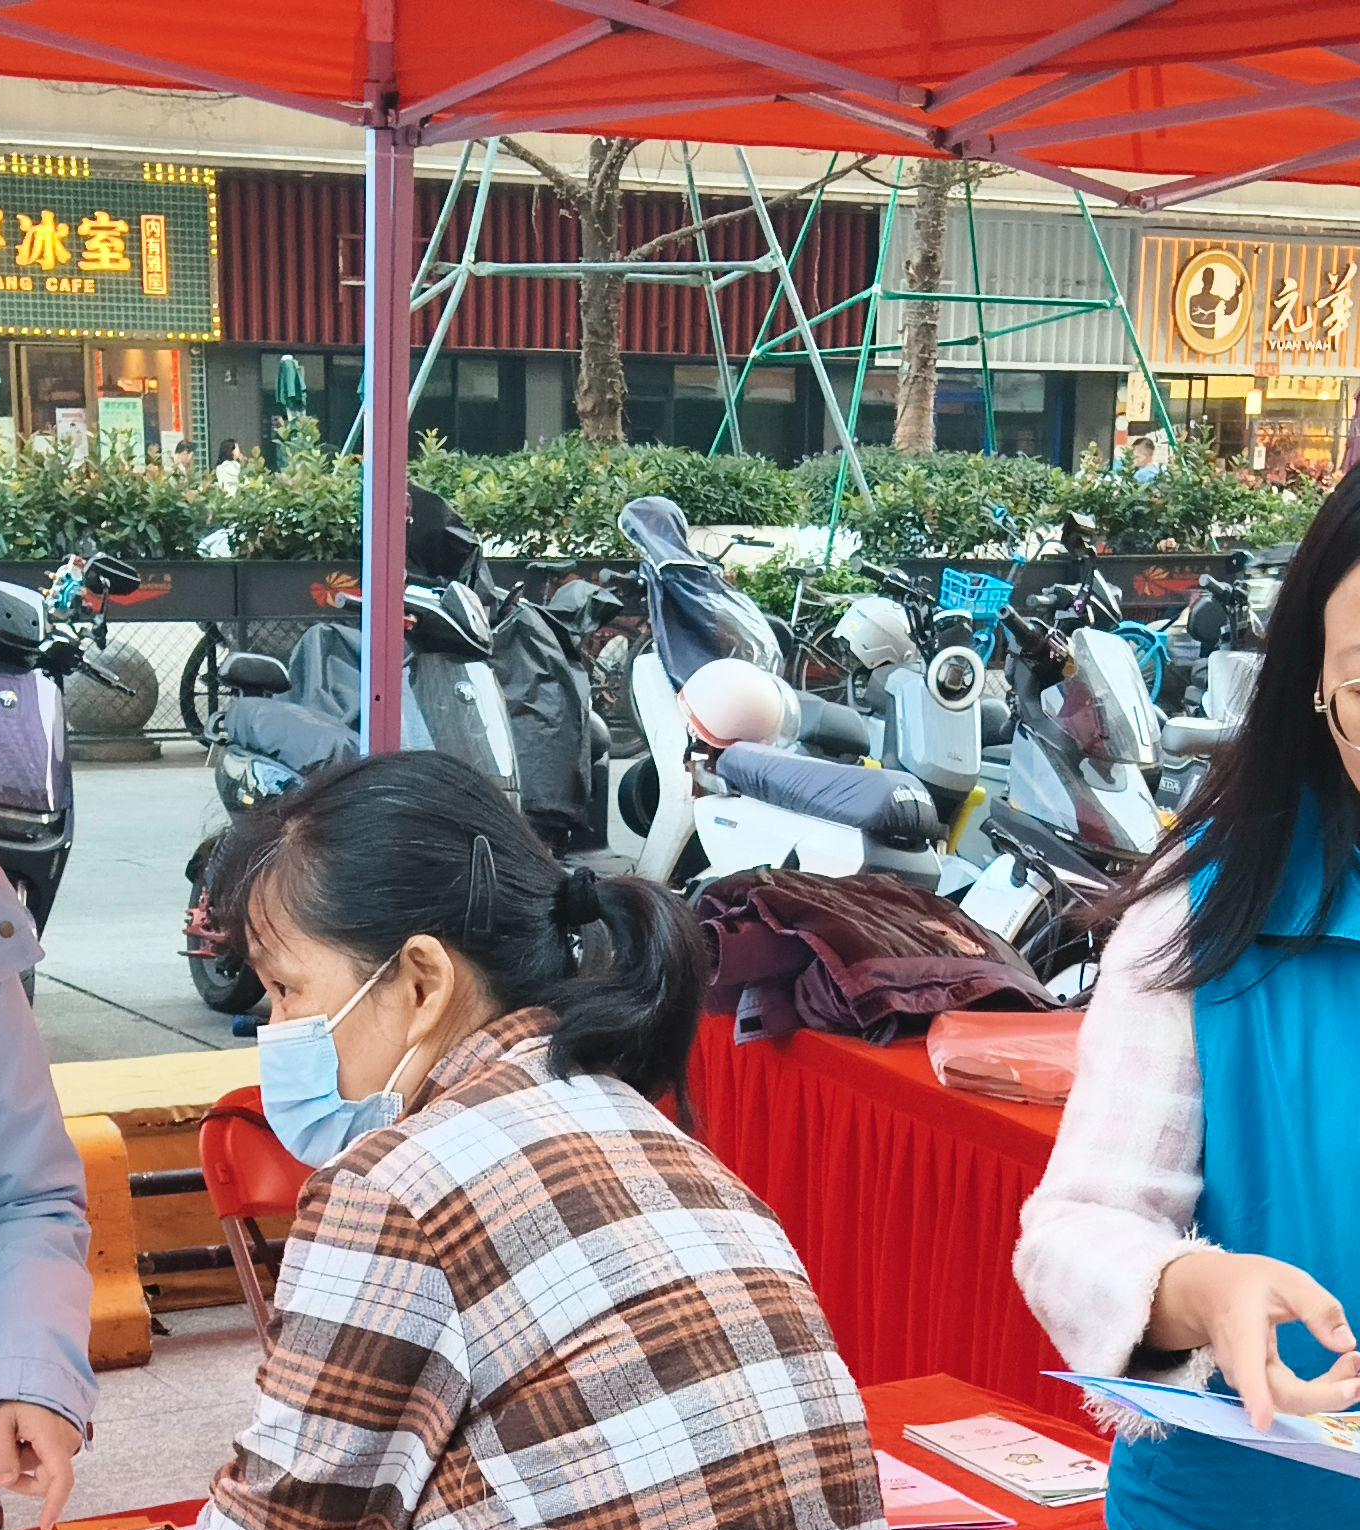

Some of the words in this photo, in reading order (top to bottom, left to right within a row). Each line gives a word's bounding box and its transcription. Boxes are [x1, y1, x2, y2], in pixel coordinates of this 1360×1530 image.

[45, 278, 95, 293] CAFE
[1268, 339, 1302, 351] YUAN
[1304, 339, 1332, 351] WAH
